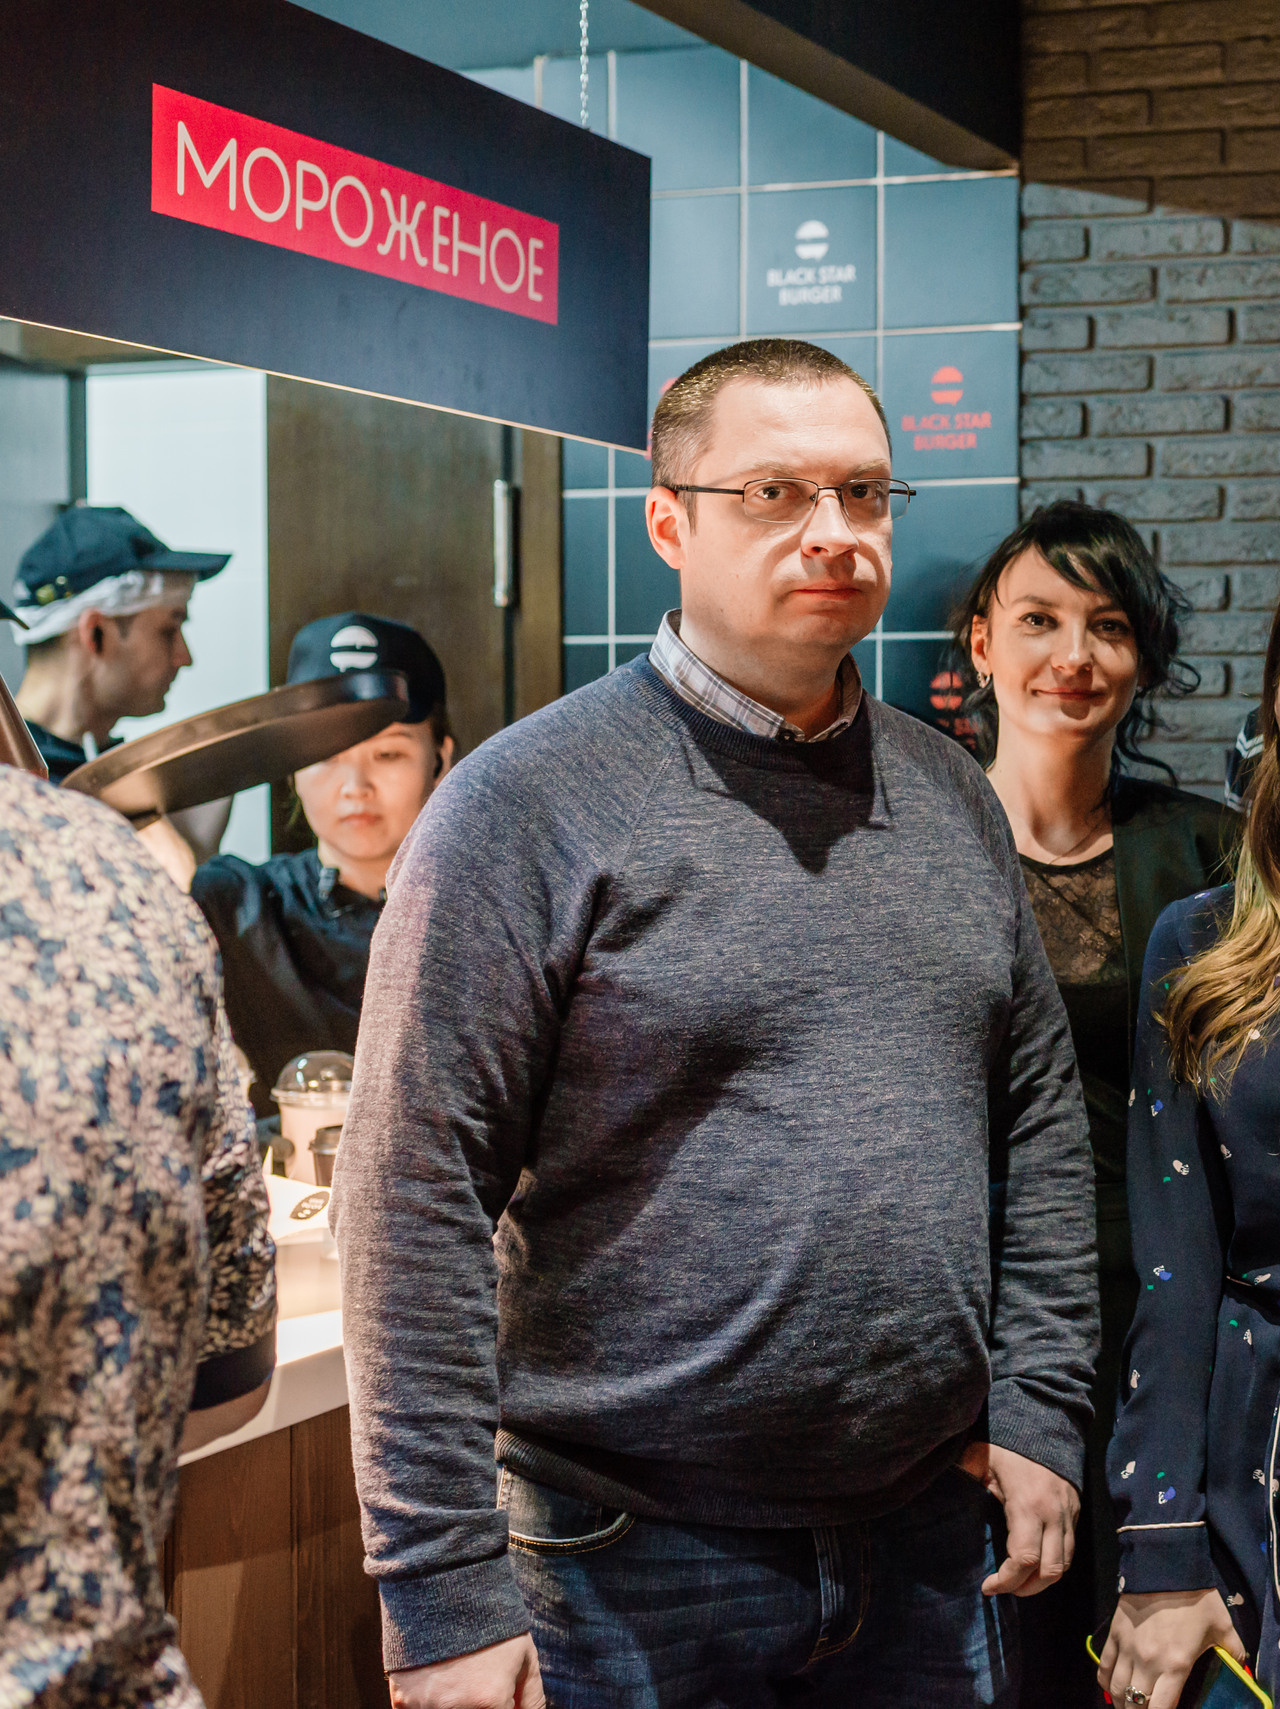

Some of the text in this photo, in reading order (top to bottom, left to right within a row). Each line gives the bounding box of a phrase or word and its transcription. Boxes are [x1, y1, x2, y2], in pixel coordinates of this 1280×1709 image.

[176, 120, 544, 301] МОРОЖЕНОЕ
[766, 264, 857, 288] BLACK STAR
[778, 285, 842, 306] BURGER
[901, 411, 992, 432] BLACK STAR
[913, 432, 977, 451] BURGER
